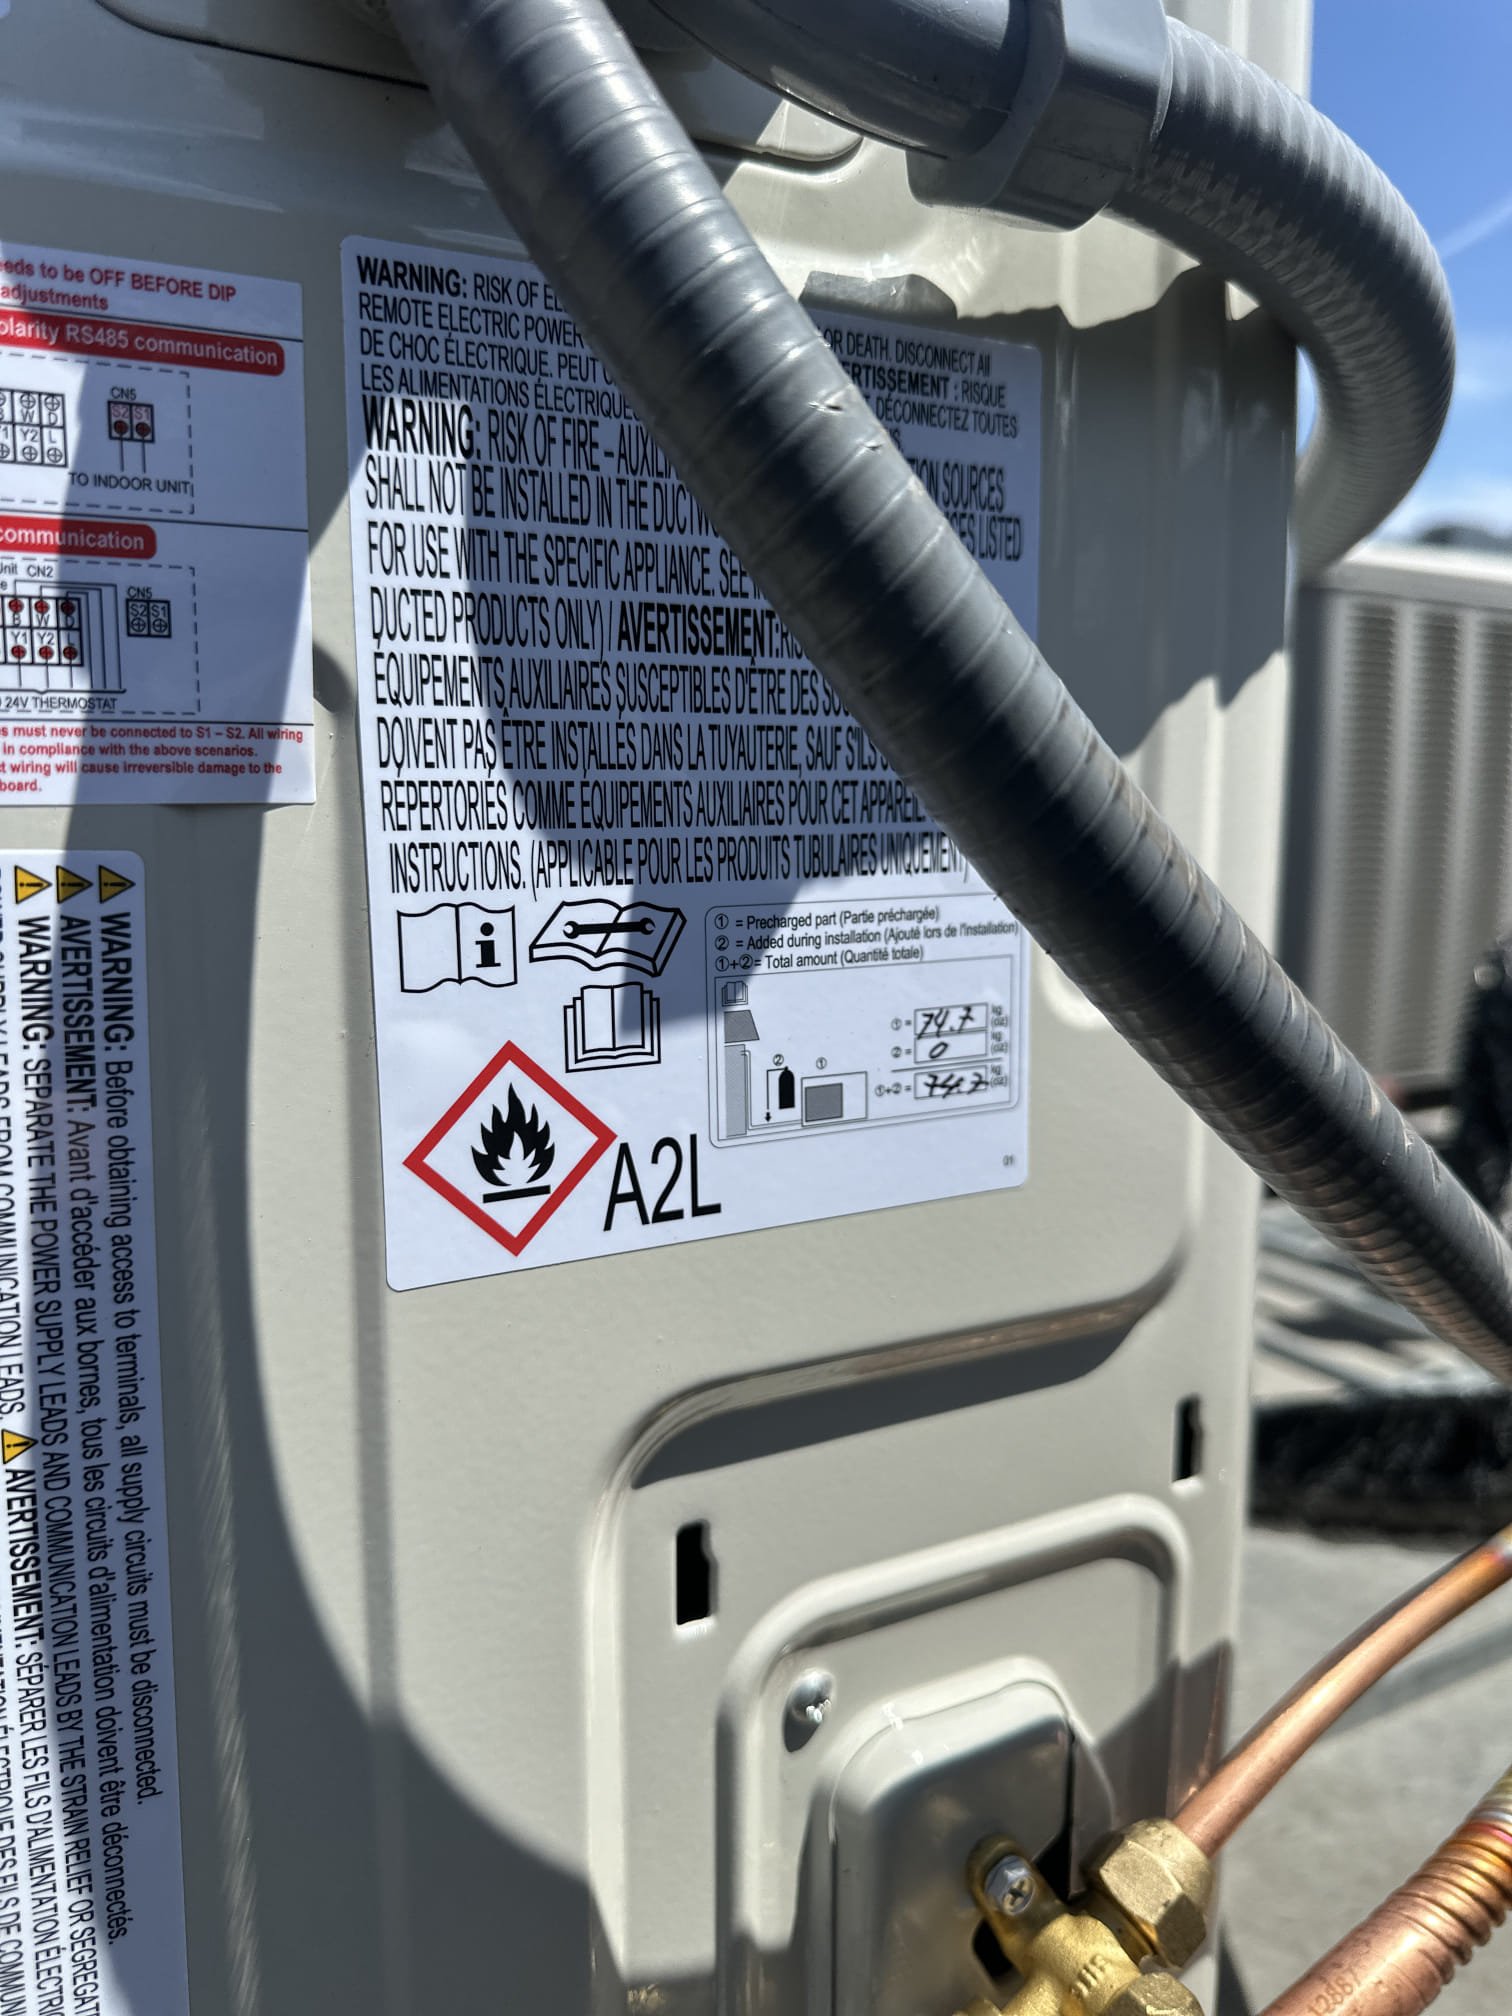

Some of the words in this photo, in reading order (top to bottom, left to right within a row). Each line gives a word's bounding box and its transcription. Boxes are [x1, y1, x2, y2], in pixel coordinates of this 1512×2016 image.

[1, 285, 108, 310] adjustments
[41, 266, 57, 281] to
[64, 266, 84, 282] be
[90, 269, 125, 287] OFF
[131, 275, 202, 298] BEFORE
[209, 285, 236, 302] DIP
[357, 256, 467, 298] WARNING:
[474, 274, 512, 305] RISK
[517, 281, 539, 308] OF
[359, 292, 432, 328] REMOTE
[438, 305, 519, 339] ELECTRIC
[66, 324, 128, 348] RS485
[135, 336, 278, 367] communication
[361, 328, 384, 357] DE
[389, 331, 439, 363] CHOC
[445, 331, 553, 379] ÉLECTRIQUE.
[558, 353, 599, 382] PEUT
[895, 342, 974, 375] DISCONNECT
[110, 387, 136, 401] CN5
[361, 364, 393, 393] LES
[398, 368, 529, 409] ALIMENTATIONS
[962, 380, 1006, 408] RISQUE
[362, 395, 481, 460] WARNING:
[488, 409, 528, 463] RISK
[534, 414, 556, 467] OF
[563, 417, 599, 472] FIRE
[876, 392, 969, 432] DÉCONNECTEZ
[972, 410, 1018, 438] TOUTES
[70, 473, 88, 486] TO
[94, 474, 152, 490] INDOOR
[157, 480, 190, 495] UNIT
[366, 454, 424, 512] SHALL
[429, 458, 467, 515] NOT
[472, 465, 495, 518] BE
[501, 468, 591, 526] INSTALLED
[597, 475, 612, 528] IN
[616, 479, 648, 531] THE
[942, 461, 1005, 513] SOURCES
[368, 521, 408, 576] FOR
[413, 524, 450, 579] USE
[454, 527, 500, 582] WITH
[504, 530, 539, 585] THE
[544, 534, 619, 591] SPECIFIC
[624, 541, 715, 597] APPLIANCE.
[978, 513, 1021, 561] LISTED
[27, 565, 54, 578] CN2
[127, 587, 152, 599] CN5
[152, 605, 168, 618] S1
[371, 587, 447, 642] DUCTED
[453, 591, 550, 648] PRODUCTS
[6, 696, 28, 709] 24V
[31, 697, 117, 710] THERMOSTAT
[510, 658, 611, 711] AUXILIAIRES
[616, 661, 731, 714] SUSCEPTIBLES
[791, 669, 819, 716] DES
[3, 743, 15, 754] in
[19, 743, 95, 757] compliance
[100, 743, 125, 755] with
[129, 744, 149, 755] the
[154, 744, 191, 756] above
[195, 745, 258, 757] scenarios.
[13, 726, 46, 737] must
[51, 729, 86, 738] never
[92, 726, 106, 738] be
[110, 727, 176, 739] connected
[180, 728, 193, 739] to
[196, 728, 211, 739] S1
[249, 729, 264, 740] All
[268, 729, 303, 743] wiring
[377, 717, 457, 770] DOIVENT
[463, 719, 496, 771] PAS
[503, 708, 547, 771] ÊTRE
[641, 721, 683, 771] DANS
[687, 724, 706, 771] LA
[708, 724, 802, 778] TUYAUTERIE,
[806, 725, 842, 771] SAUF
[10, 762, 51, 777] wiring
[55, 761, 77, 773] will
[81, 764, 119, 773] cause
[124, 762, 194, 773] irreversible
[198, 763, 245, 776] damage
[249, 764, 261, 774] to
[265, 763, 282, 774] the
[513, 780, 576, 830] COMME
[696, 781, 784, 827] AUXILIAIRES
[789, 780, 829, 825] POUR
[831, 780, 859, 824] CET
[390, 840, 526, 894] INSTRUCTIONS.
[531, 838, 633, 902] (APPLICABLE
[638, 838, 682, 886] POUR
[686, 838, 713, 883] LES
[718, 836, 790, 882] PRODUITS
[794, 834, 877, 879] TUBULAIRES
[747, 913, 812, 933] Precharged
[815, 912, 837, 927] part
[839, 909, 874, 928] (Partie
[877, 905, 940, 926] préchargée)
[747, 933, 785, 951] Added
[788, 929, 822, 949] during
[824, 926, 881, 945] installation
[884, 926, 921, 945] (Ajouté
[924, 925, 942, 940] lors
[944, 925, 957, 938] de
[101, 912, 135, 1052] WARNING:
[765, 954, 793, 969] Total
[796, 952, 838, 967] amount
[840, 946, 890, 968] (Quantité
[892, 945, 924, 963] totale)
[18, 917, 55, 1051] WARNING:
[60, 915, 98, 1113] AVERTISSEMENT:
[23, 1059, 55, 1168] SEPARATE
[104, 1061, 134, 1128] Before
[67, 1120, 96, 1181] Avant
[28, 1172, 56, 1214] THE
[103, 1135, 137, 1228] obtaining
[602, 1133, 722, 1232] A2L
[30, 1220, 59, 1294] POWER
[69, 1188, 102, 1290] d'accéder
[110, 1234, 134, 1304] access
[34, 1300, 66, 1376] SUPPLY
[74, 1298, 98, 1336] aux
[113, 1310, 141, 1328] to
[75, 1341, 104, 1414] bornes,
[114, 1335, 147, 1431] terminals,
[38, 1382, 69, 1446] LEADS
[81, 1419, 107, 1459] tous
[42, 1452, 71, 1491] AND
[121, 1435, 148, 1458] all
[84, 1464, 111, 1492] les
[116, 1463, 151, 1523] supply
[84, 1498, 113, 1562] circuits
[5, 1468, 44, 1647] AVERTISSEMENT:
[45, 1496, 79, 1647] COMMUNICATION
[123, 1530, 152, 1596] circuits
[88, 1568, 121, 1698] d'alimentation
[127, 1601, 154, 1647] must
[52, 1649, 81, 1708] LEADS
[130, 1650, 157, 1674] be
[15, 1653, 49, 1735] SÉPARER
[56, 1712, 83, 1733] BY
[94, 1706, 121, 1776] doivent
[132, 1680, 163, 1805] disconnected.
[20, 1739, 48, 1769] LES
[58, 1736, 85, 1772] THE
[23, 1774, 50, 1808] FILS
[60, 1776, 88, 1836] STRAIN
[99, 1780, 125, 1817] être
[25, 1812, 60, 1945] D'ALIMENTATION
[65, 1840, 92, 1894] RELIEF
[103, 1824, 133, 1946] déconnectés.
[68, 1900, 94, 1926] OR
